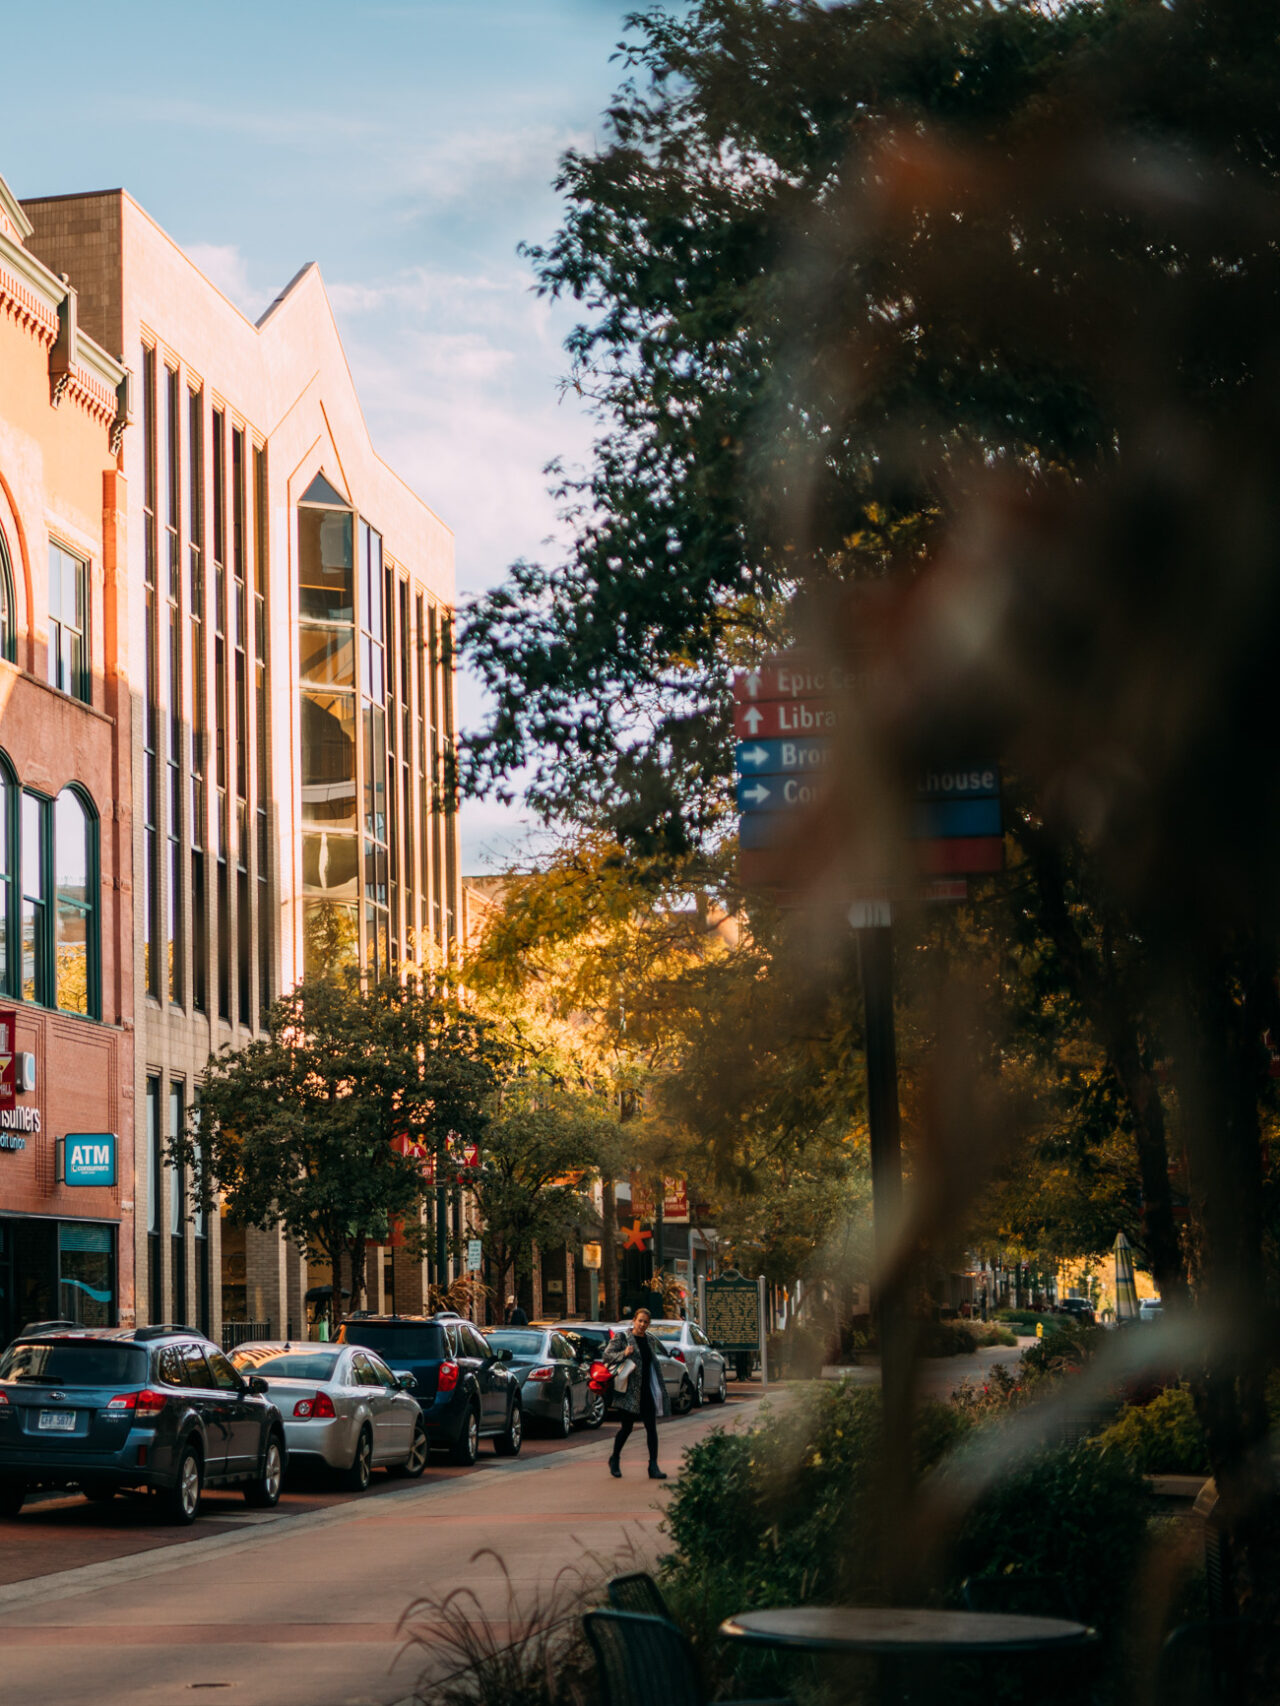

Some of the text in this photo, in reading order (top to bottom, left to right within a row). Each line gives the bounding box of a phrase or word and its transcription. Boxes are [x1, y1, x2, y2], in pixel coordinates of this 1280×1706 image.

[777, 667, 825, 697] Epic
[9, 1134, 26, 1150] union
[71, 1145, 110, 1165] ATM
